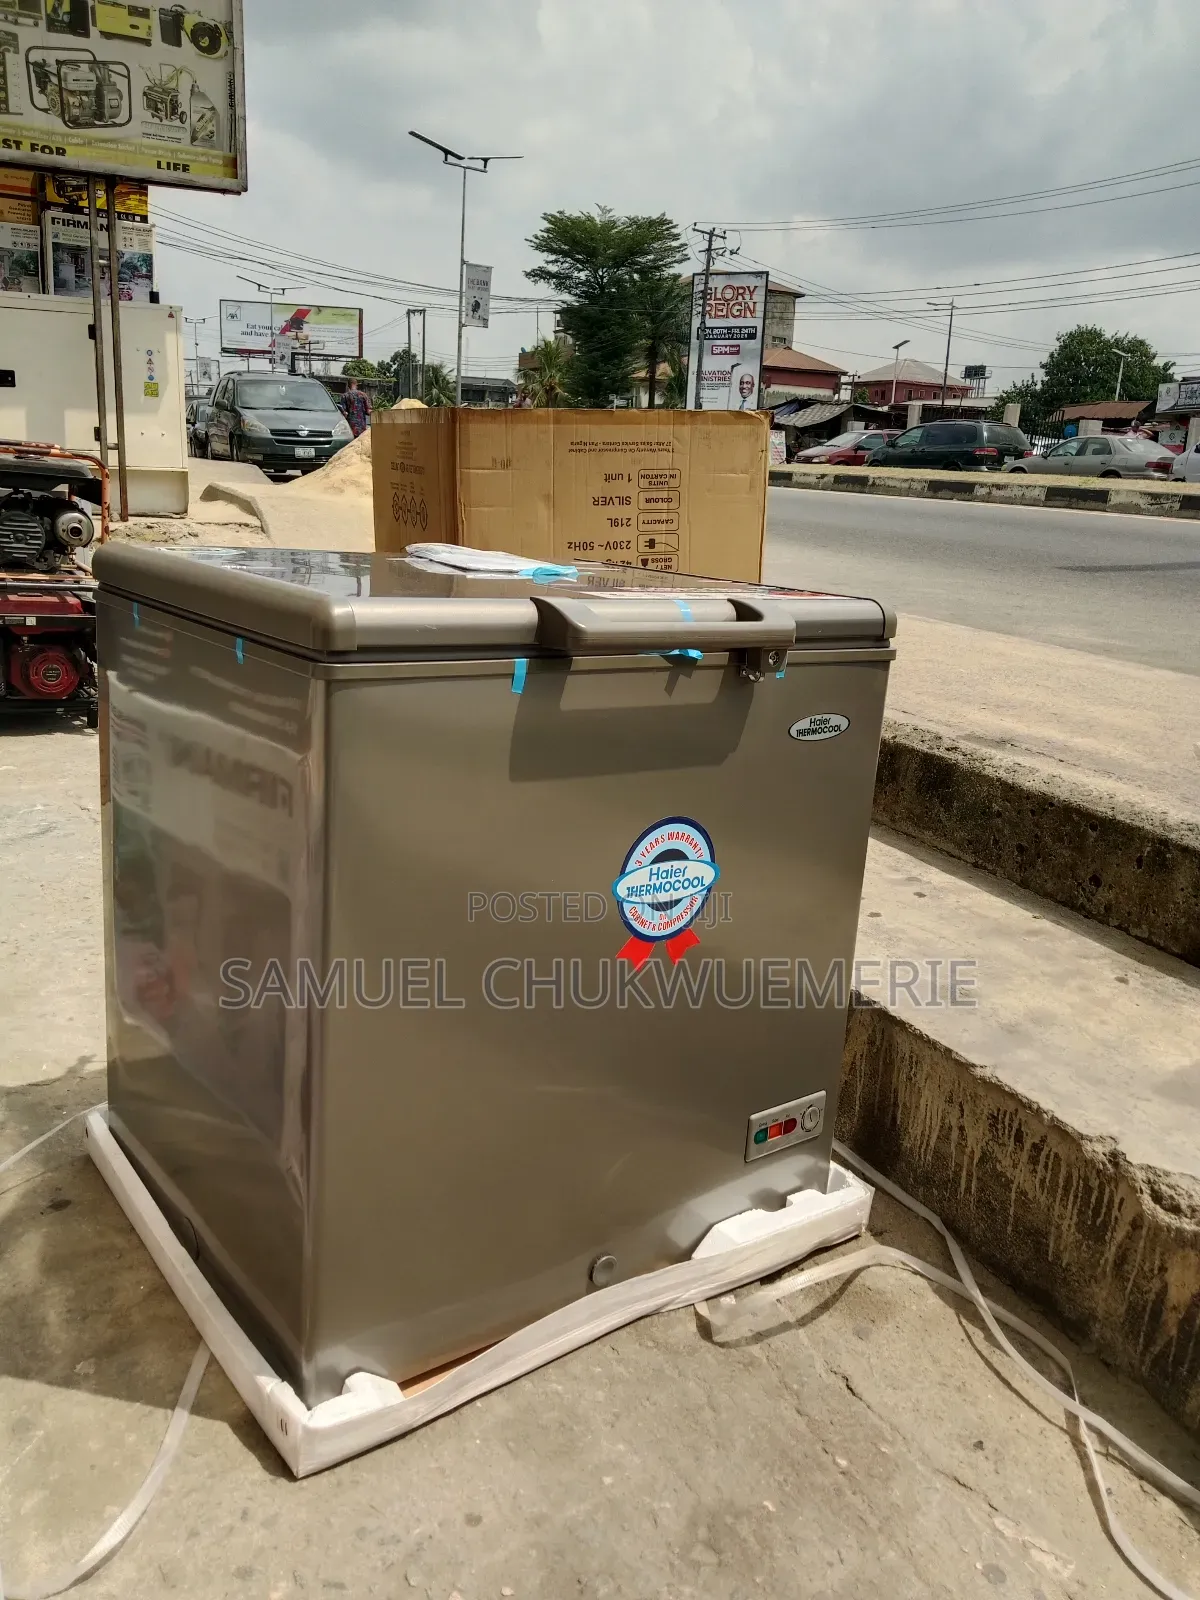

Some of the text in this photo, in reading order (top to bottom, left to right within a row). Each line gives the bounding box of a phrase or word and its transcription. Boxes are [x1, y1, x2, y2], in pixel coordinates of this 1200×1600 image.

[30, 142, 67, 157] FOR
[156, 160, 190, 174] LIFE
[226, 312, 238, 320] AXA
[705, 301, 758, 320] REIGN
[246, 322, 258, 330] Eat
[712, 346, 730, 354] 5PM
[604, 473, 633, 483] 1 unit
[592, 496, 632, 506] SILVER
[606, 518, 632, 527] 219L
[567, 540, 595, 551] 50Hz
[809, 715, 831, 727] Haier
[796, 723, 842, 738] THERMOCOOL
[635, 831, 704, 867] 3 YEARS WARRANTY
[648, 865, 687, 882] Haier
[626, 875, 706, 899] THERMOCOOL
[628, 905, 652, 931] CABINET
[657, 895, 699, 932] COMPRESSOR
